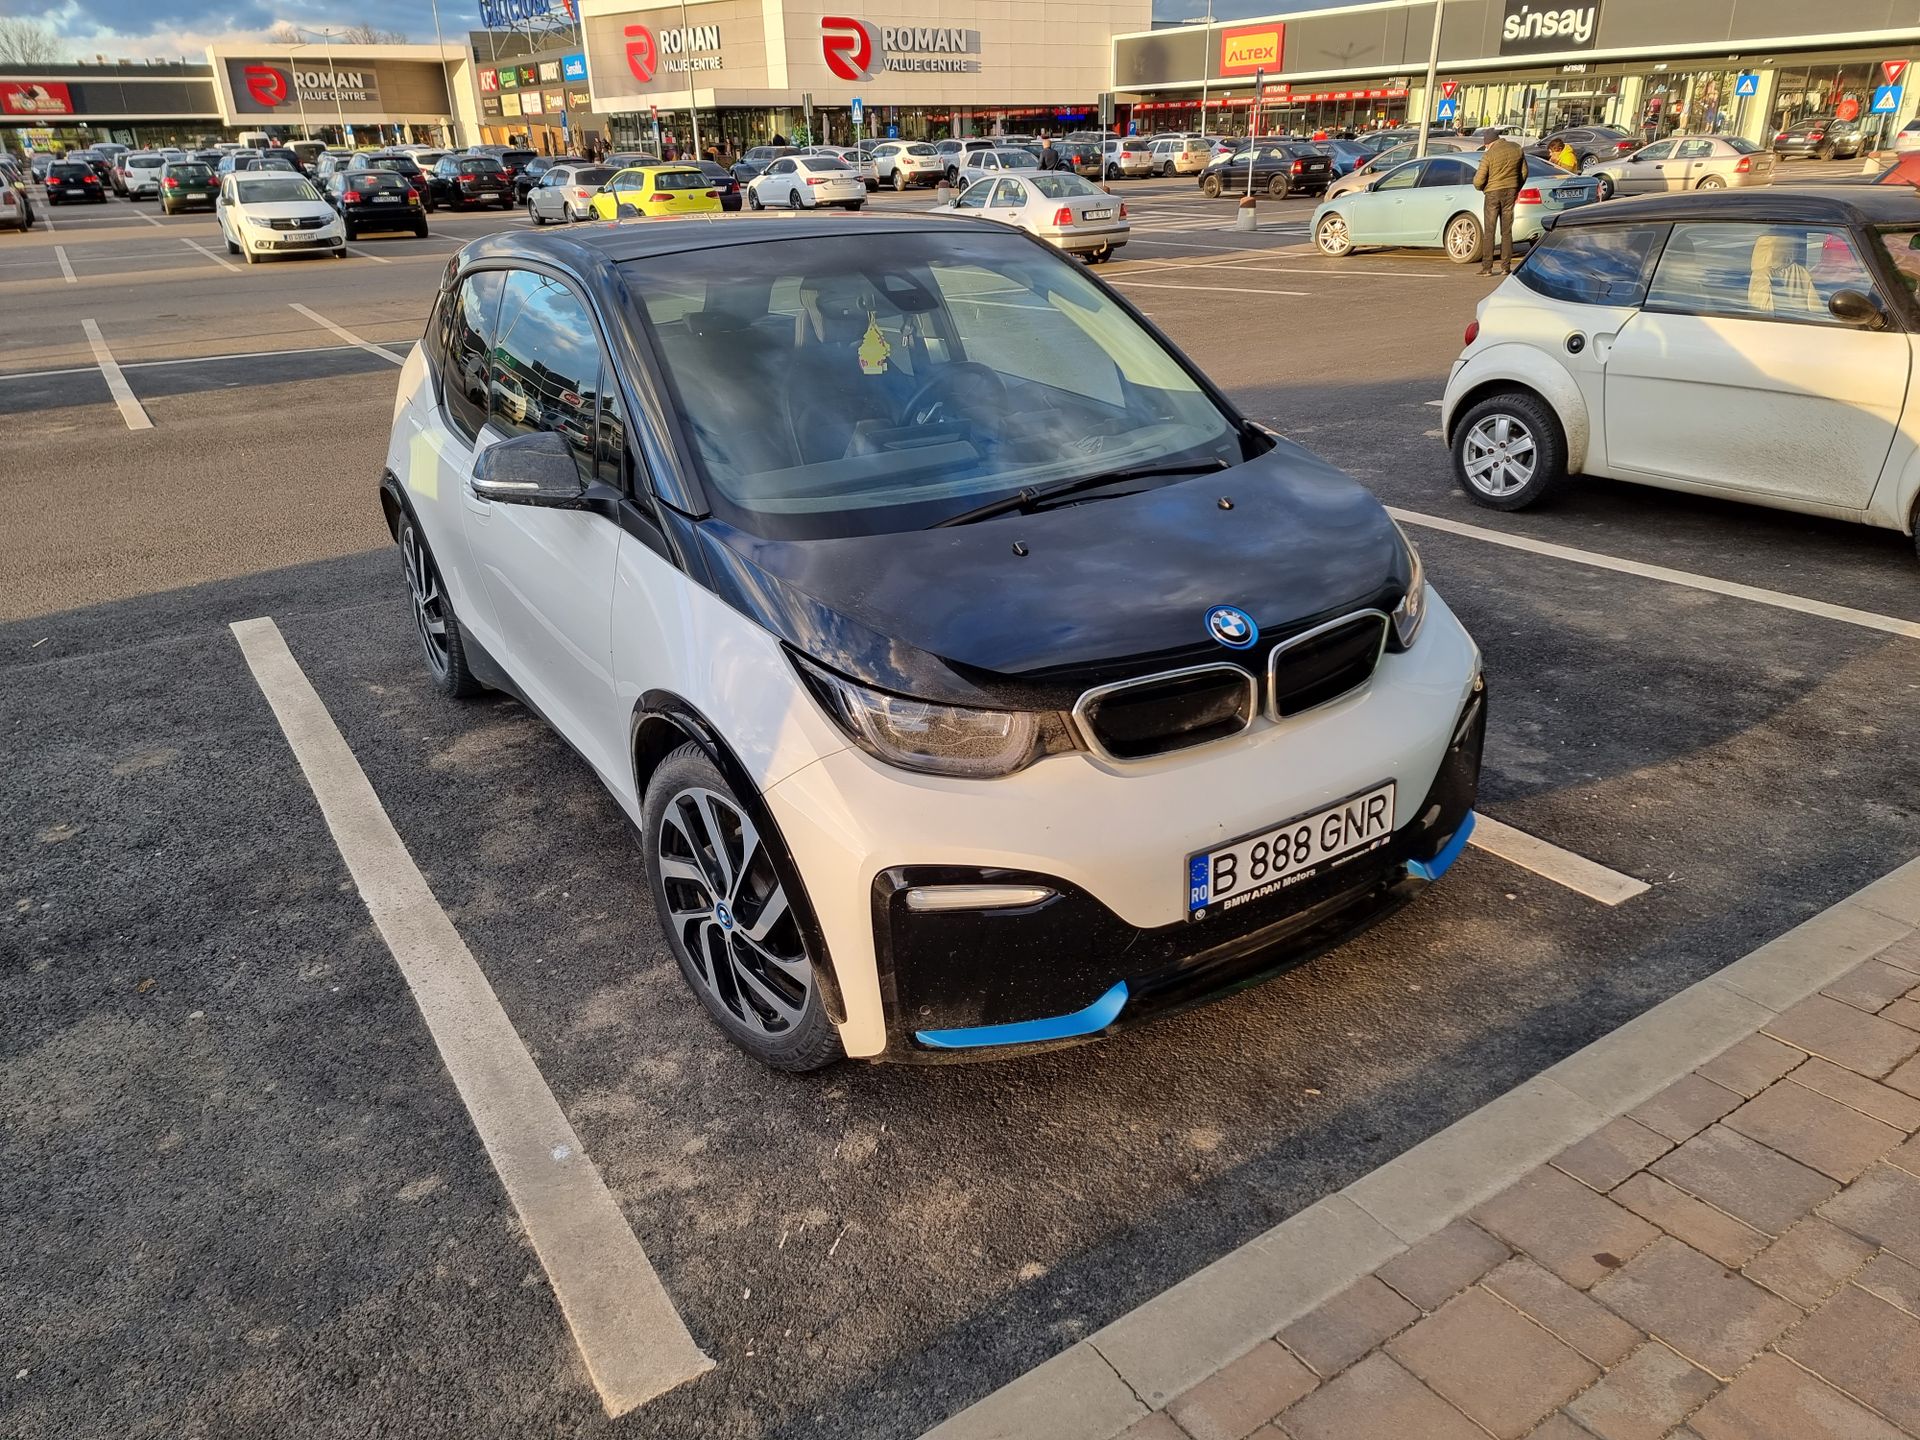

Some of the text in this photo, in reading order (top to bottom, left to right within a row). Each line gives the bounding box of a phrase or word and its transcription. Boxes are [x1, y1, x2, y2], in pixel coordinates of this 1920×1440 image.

[1503, 5, 1595, 42] sinsay
[659, 25, 719, 54] ROMAN
[881, 27, 967, 52] ROMAN
[663, 56, 720, 73] VALUE CENTRE
[883, 58, 967, 72] VALUE CENTRE
[294, 72, 363, 88] ROMAN
[480, 70, 496, 90] KFC
[298, 91, 366, 101] VALUE CENTRE
[1212, 609, 1241, 624] BMW
[1211, 794, 1387, 897] B 888 GNR
[1191, 884, 1208, 904] RO
[1223, 892, 1251, 910] BMW
[1282, 868, 1317, 887] Motors
